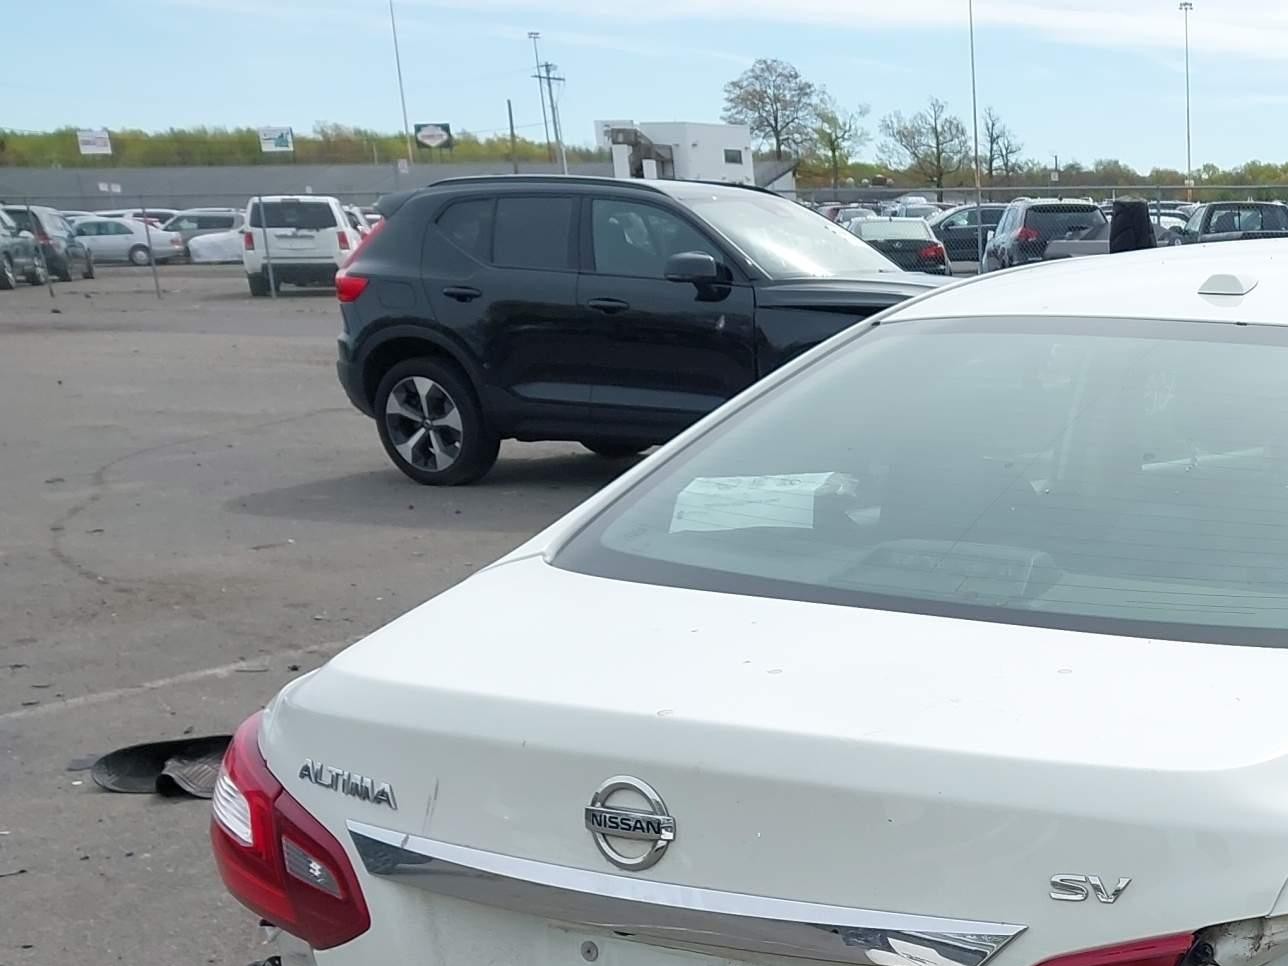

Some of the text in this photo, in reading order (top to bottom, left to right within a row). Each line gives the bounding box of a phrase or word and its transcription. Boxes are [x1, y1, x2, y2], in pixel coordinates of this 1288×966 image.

[299, 758, 398, 810] ALTIMA
[591, 812, 661, 835] NISSAN
[1049, 873, 1133, 905] SV
